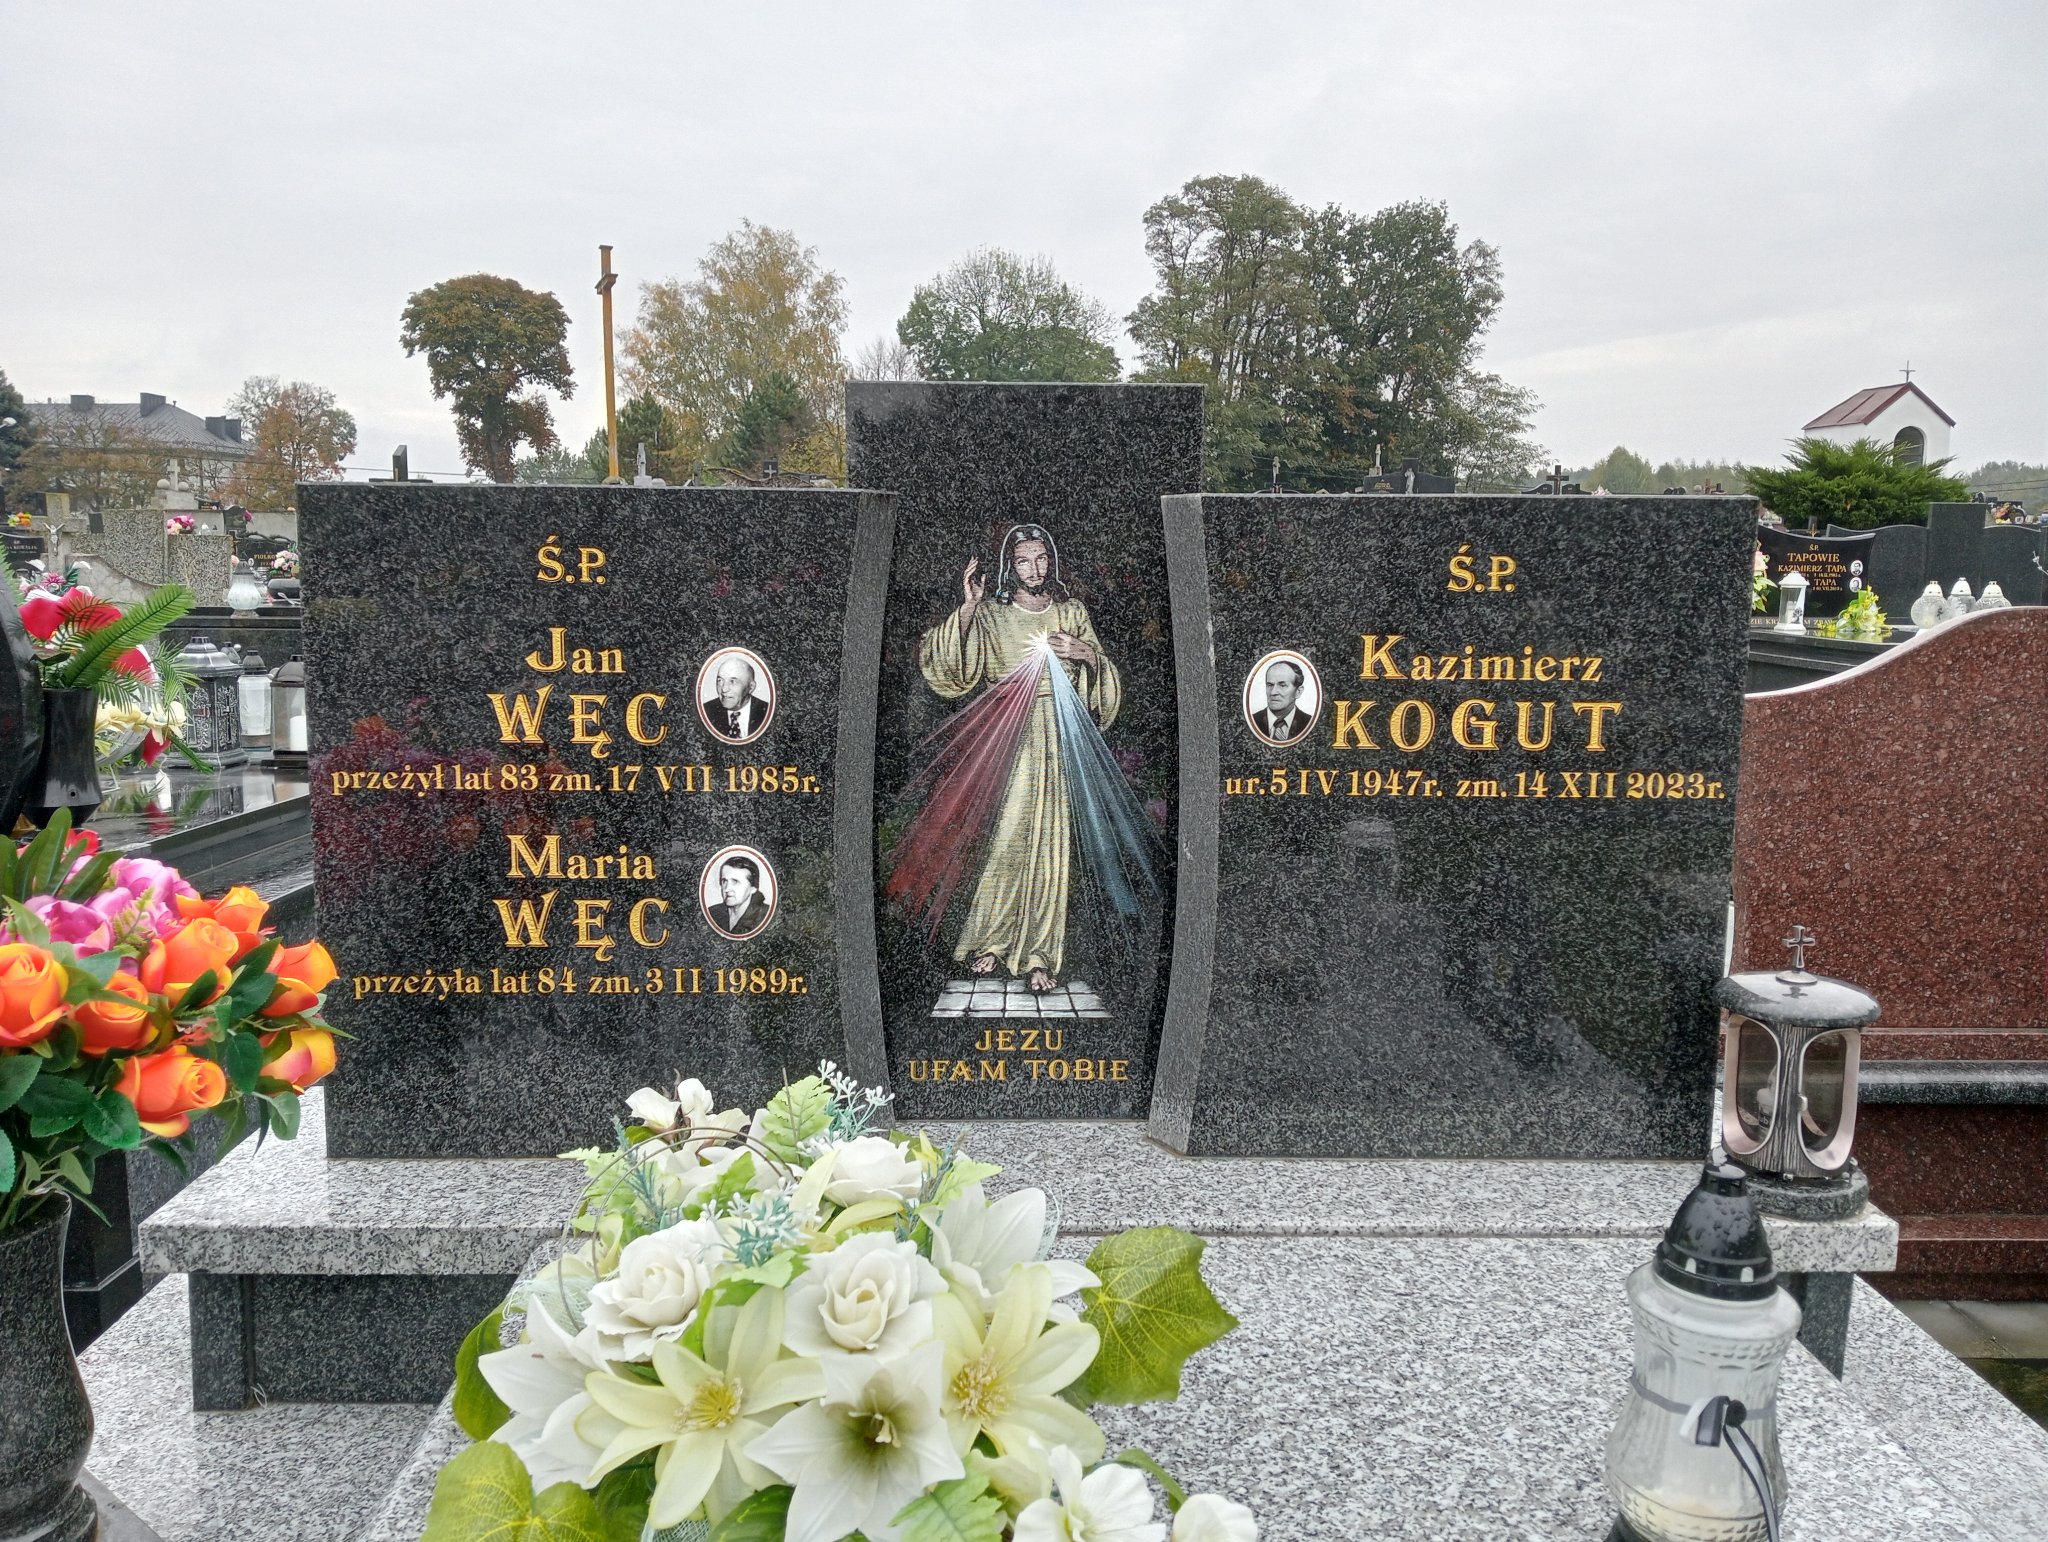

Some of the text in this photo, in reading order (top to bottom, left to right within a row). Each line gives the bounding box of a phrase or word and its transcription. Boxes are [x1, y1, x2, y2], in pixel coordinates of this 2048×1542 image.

[537, 535, 607, 584] Ś.P.
[1447, 544, 1517, 593] Ś.P.
[1778, 564, 1847, 573] KAZIMIERZ TAPA
[1787, 553, 1840, 563] TAPOWIE
[1813, 578, 1837, 586] TAPA
[525, 627, 625, 674] Jan
[1359, 634, 1602, 683] Kazimierz
[487, 683, 668, 758] WĘC
[1331, 698, 1623, 753] KOGUT
[331, 763, 821, 798] przeżył lat 83 zm. 17 VII 1985r.
[1226, 767, 1726, 800] ur. 5 IV 1947r. zm. 14 XII 2023r.
[506, 834, 657, 880] Maria
[494, 889, 670, 962] WĘC
[352, 966, 809, 1001] przeżyła lat 84 zm. 3 II 1989r.
[974, 1029, 1063, 1051] JEZU
[909, 1058, 1131, 1082] UFAM TOBIE
